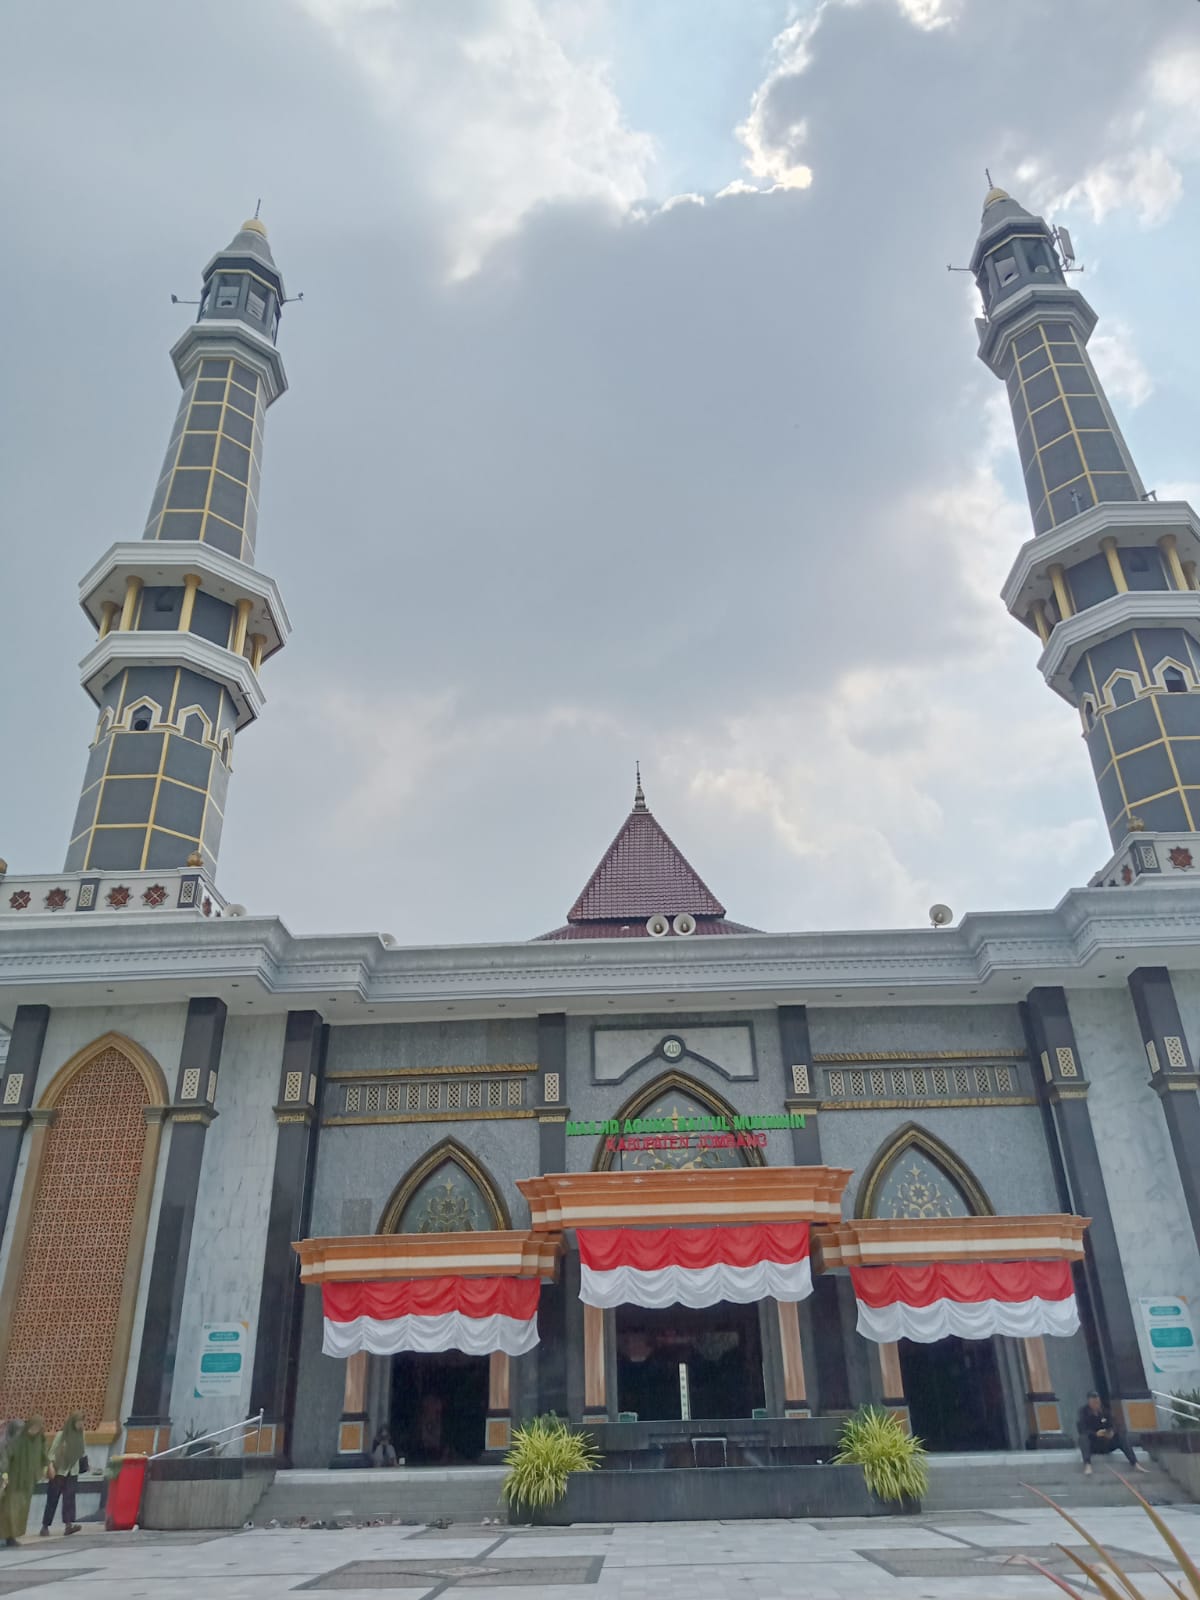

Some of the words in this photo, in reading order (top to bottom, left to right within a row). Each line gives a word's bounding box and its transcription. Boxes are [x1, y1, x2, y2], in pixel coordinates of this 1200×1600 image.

[566, 1119, 619, 1136] MASJID
[624, 1117, 674, 1134] AGUNG
[677, 1115, 730, 1133] BAITUL
[605, 1135, 689, 1152] KABUPATEN
[697, 1132, 768, 1149] JOMBANG
